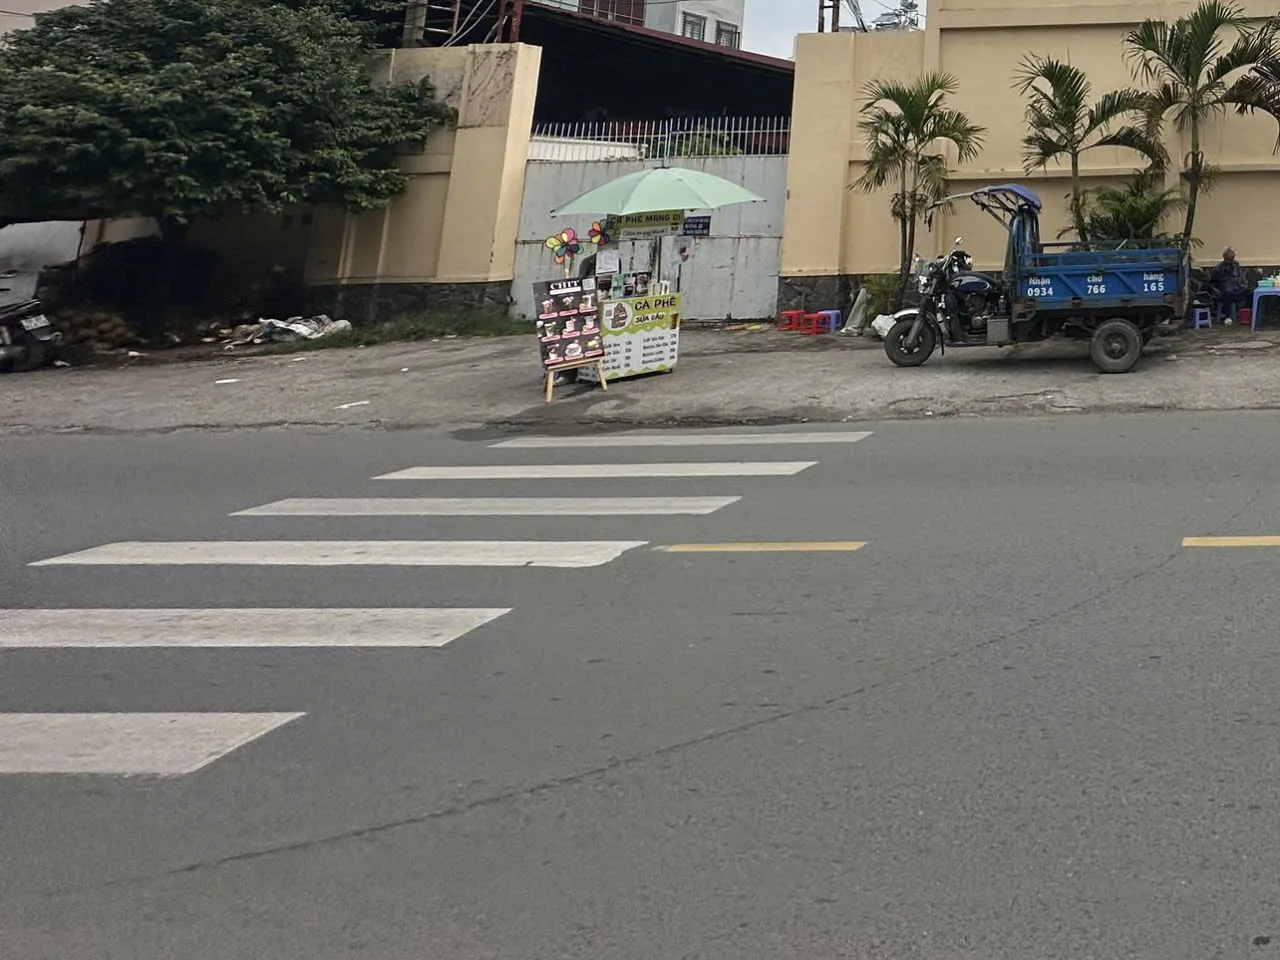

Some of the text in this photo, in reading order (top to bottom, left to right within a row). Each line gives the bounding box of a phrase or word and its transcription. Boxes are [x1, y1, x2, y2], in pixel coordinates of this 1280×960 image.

[1027, 282, 1165, 297] 0934 766 165
